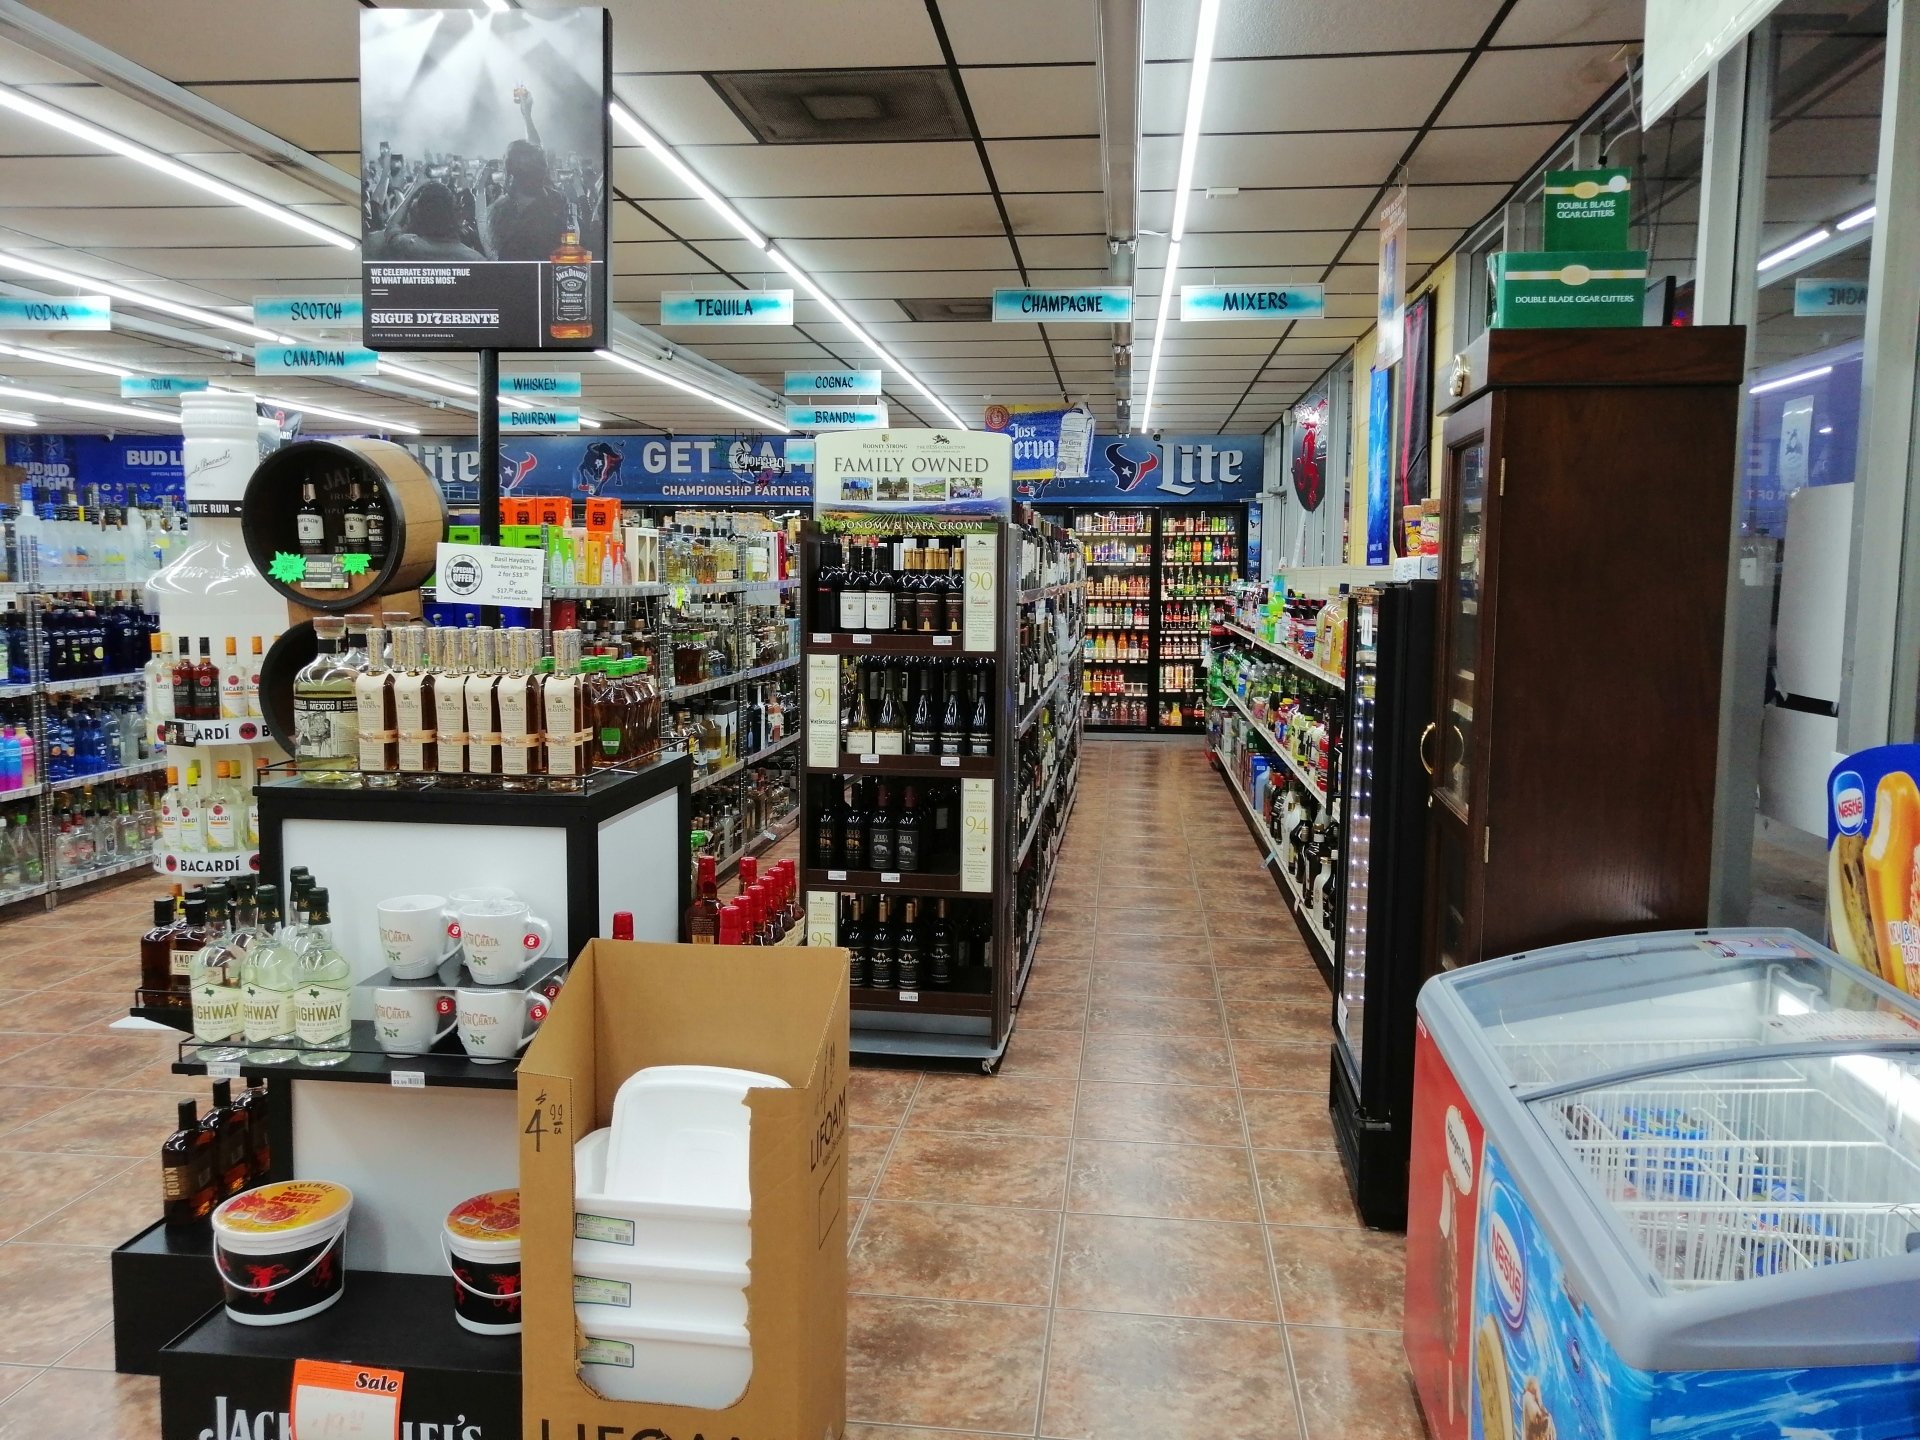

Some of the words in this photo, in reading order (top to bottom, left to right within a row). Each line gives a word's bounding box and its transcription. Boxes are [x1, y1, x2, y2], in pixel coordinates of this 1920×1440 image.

[1557, 202, 1588, 210] DOUBLE
[1589, 200, 1616, 209] BLADE
[1556, 211, 1580, 219] CIGAR
[1581, 209, 1615, 218] CUTTERS
[371, 268, 382, 276] WE
[383, 268, 421, 277] CELEBRATE
[422, 268, 451, 277] STAYING
[452, 268, 471, 277] TRUE
[371, 277, 380, 285] TO
[381, 277, 401, 285] WHAT
[402, 277, 434, 285] MATTERS
[435, 277, 457, 285] MOST.
[695, 298, 754, 317] TEQUILA
[1021, 294, 1104, 314] CHAMPAGNE
[1222, 292, 1289, 311] MIXERS
[1515, 296, 1547, 304] DOUBLE
[1600, 295, 1634, 303] CUTTERS
[24, 304, 69, 321] VODKA
[290, 302, 343, 321] SCOTCH
[371, 312, 414, 325] SIGUE
[283, 349, 346, 368] CANADIAN
[150, 378, 172, 391] RUM
[512, 377, 557, 391] WHISKEY
[814, 376, 855, 389] COGNAC
[511, 411, 557, 426] BOURBON
[814, 411, 856, 425] BRANDY
[1014, 439, 1055, 460] ervo
[126, 450, 168, 466] BUD
[643, 442, 716, 474] GET
[834, 457, 905, 473] FAMILY
[912, 457, 989, 473] OWNED
[1157, 444, 1243, 495] Lite
[662, 485, 752, 496] CHAMPIONSHIP
[755, 485, 810, 496] PARTNER
[210, 504, 230, 514] RUM
[841, 521, 889, 530] SONOMA
[893, 521, 901, 530] &
[906, 522, 935, 530] NAPA
[939, 521, 983, 530] GROWN
[452, 566, 475, 574] SPECIAL
[452, 574, 474, 583] OFFER
[969, 571, 993, 591] 90
[814, 687, 832, 706] 91
[196, 724, 230, 740] ARDÍ
[1838, 798, 1864, 820] Nestlé
[965, 816, 989, 835] 94
[180, 855, 241, 872] BACARDÍ
[451, 926, 460, 935] 8
[527, 937, 535, 946] 8
[548, 988, 555, 996] 8
[194, 1002, 239, 1020] IGHWAY
[441, 1002, 449, 1010] 8
[535, 1009, 542, 1017] 8
[810, 1085, 846, 1173] LIFOAM
[164, 1167, 181, 1197] KNOB
[1491, 1223, 1523, 1303] Nestlé
[355, 1372, 399, 1393] Sale
